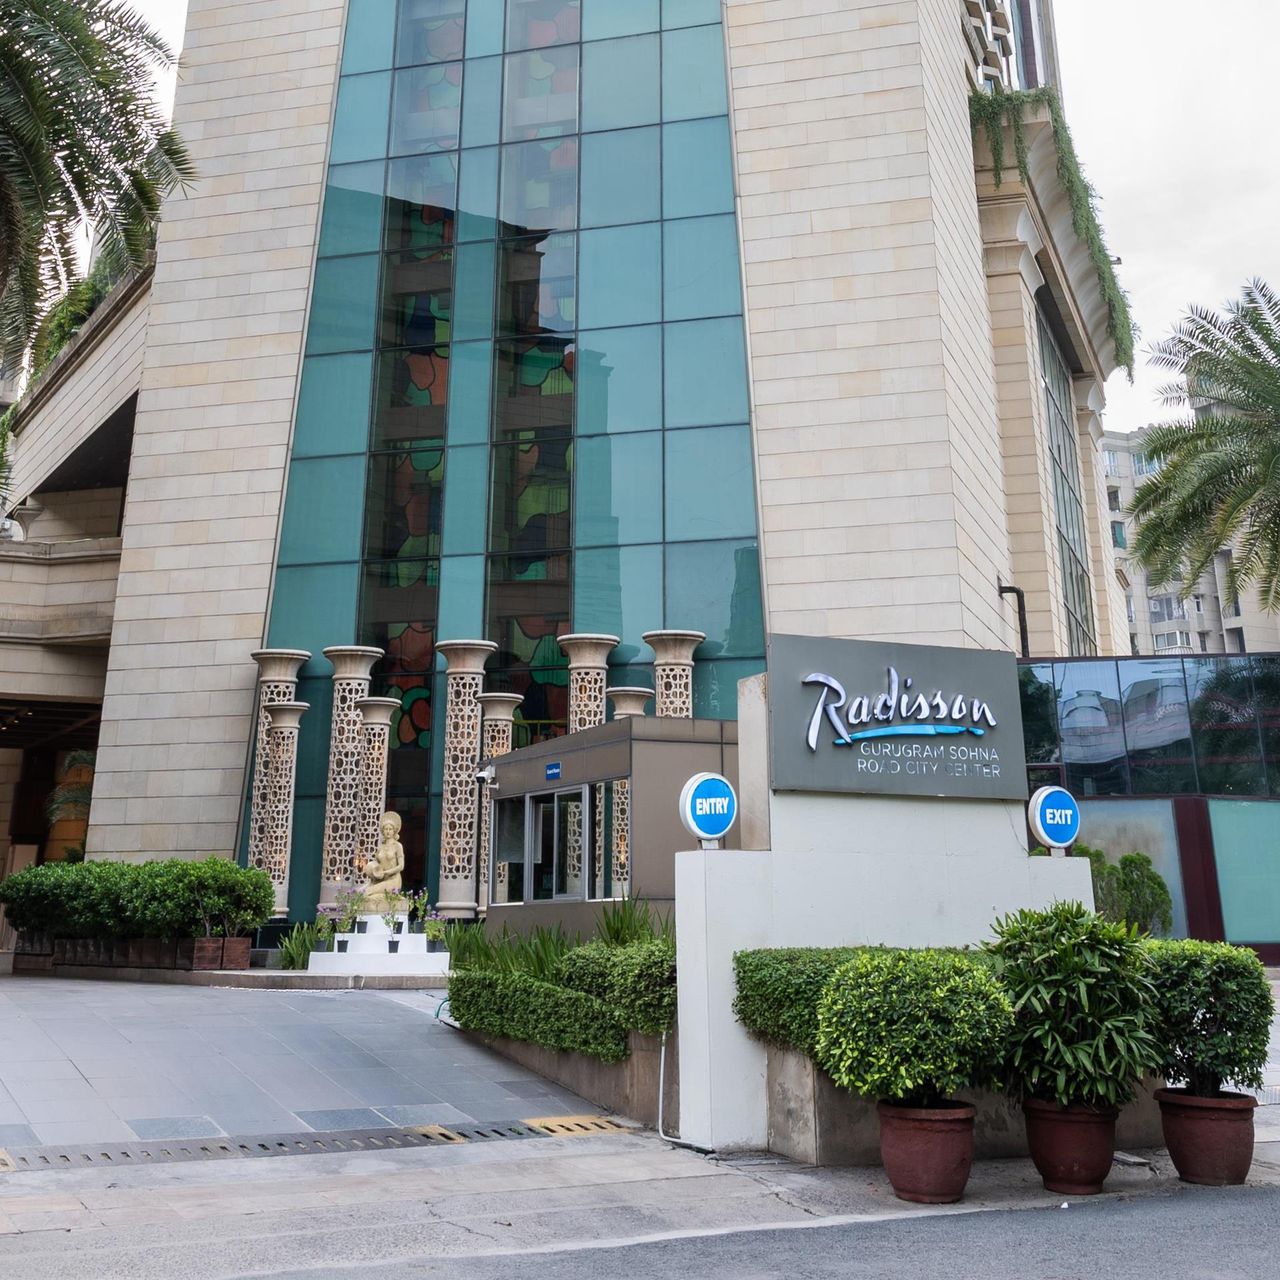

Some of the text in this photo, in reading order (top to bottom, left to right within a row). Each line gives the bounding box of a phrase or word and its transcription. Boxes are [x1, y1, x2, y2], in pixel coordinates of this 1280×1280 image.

[801, 666, 998, 753] Radisson
[860, 741, 1000, 761] GURUGRAM SOHNA
[857, 758, 1001, 778] ROAD CITY CENTER
[695, 797, 730, 816] ENTRY
[1045, 808, 1073, 825] EXIT
